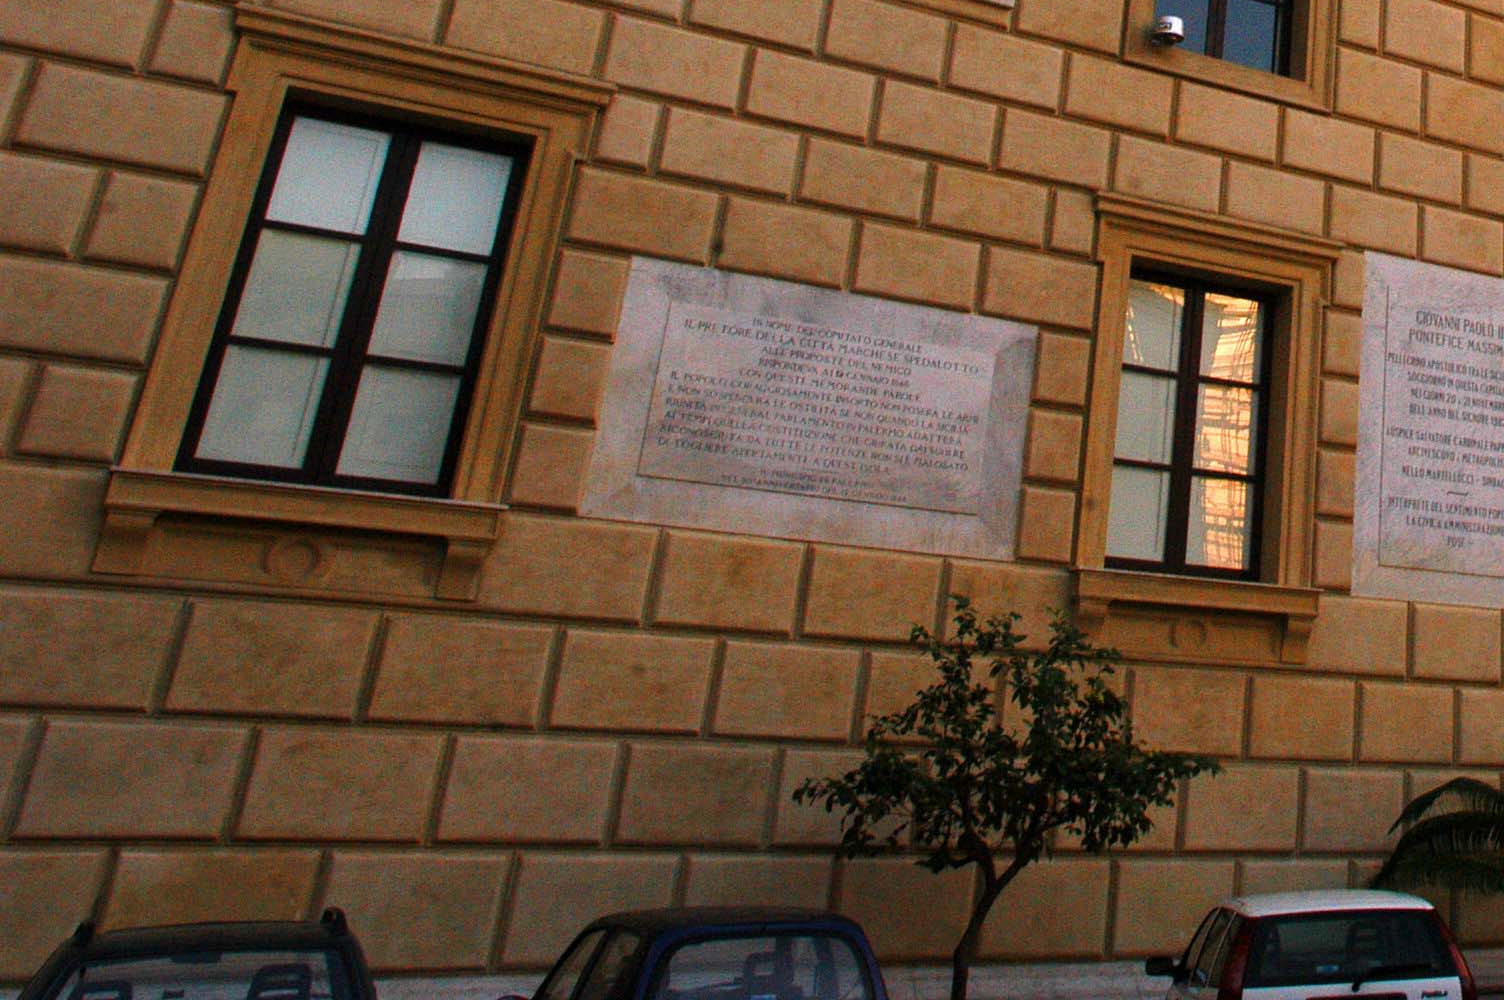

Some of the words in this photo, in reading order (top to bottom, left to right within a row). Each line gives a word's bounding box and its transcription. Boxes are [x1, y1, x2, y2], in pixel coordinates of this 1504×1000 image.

[1415, 310, 1460, 332] GIOVANNI
[1462, 318, 1494, 338] PAOLO
[1497, 323, 1504, 340] II
[1408, 328, 1463, 350] PONTEFICE
